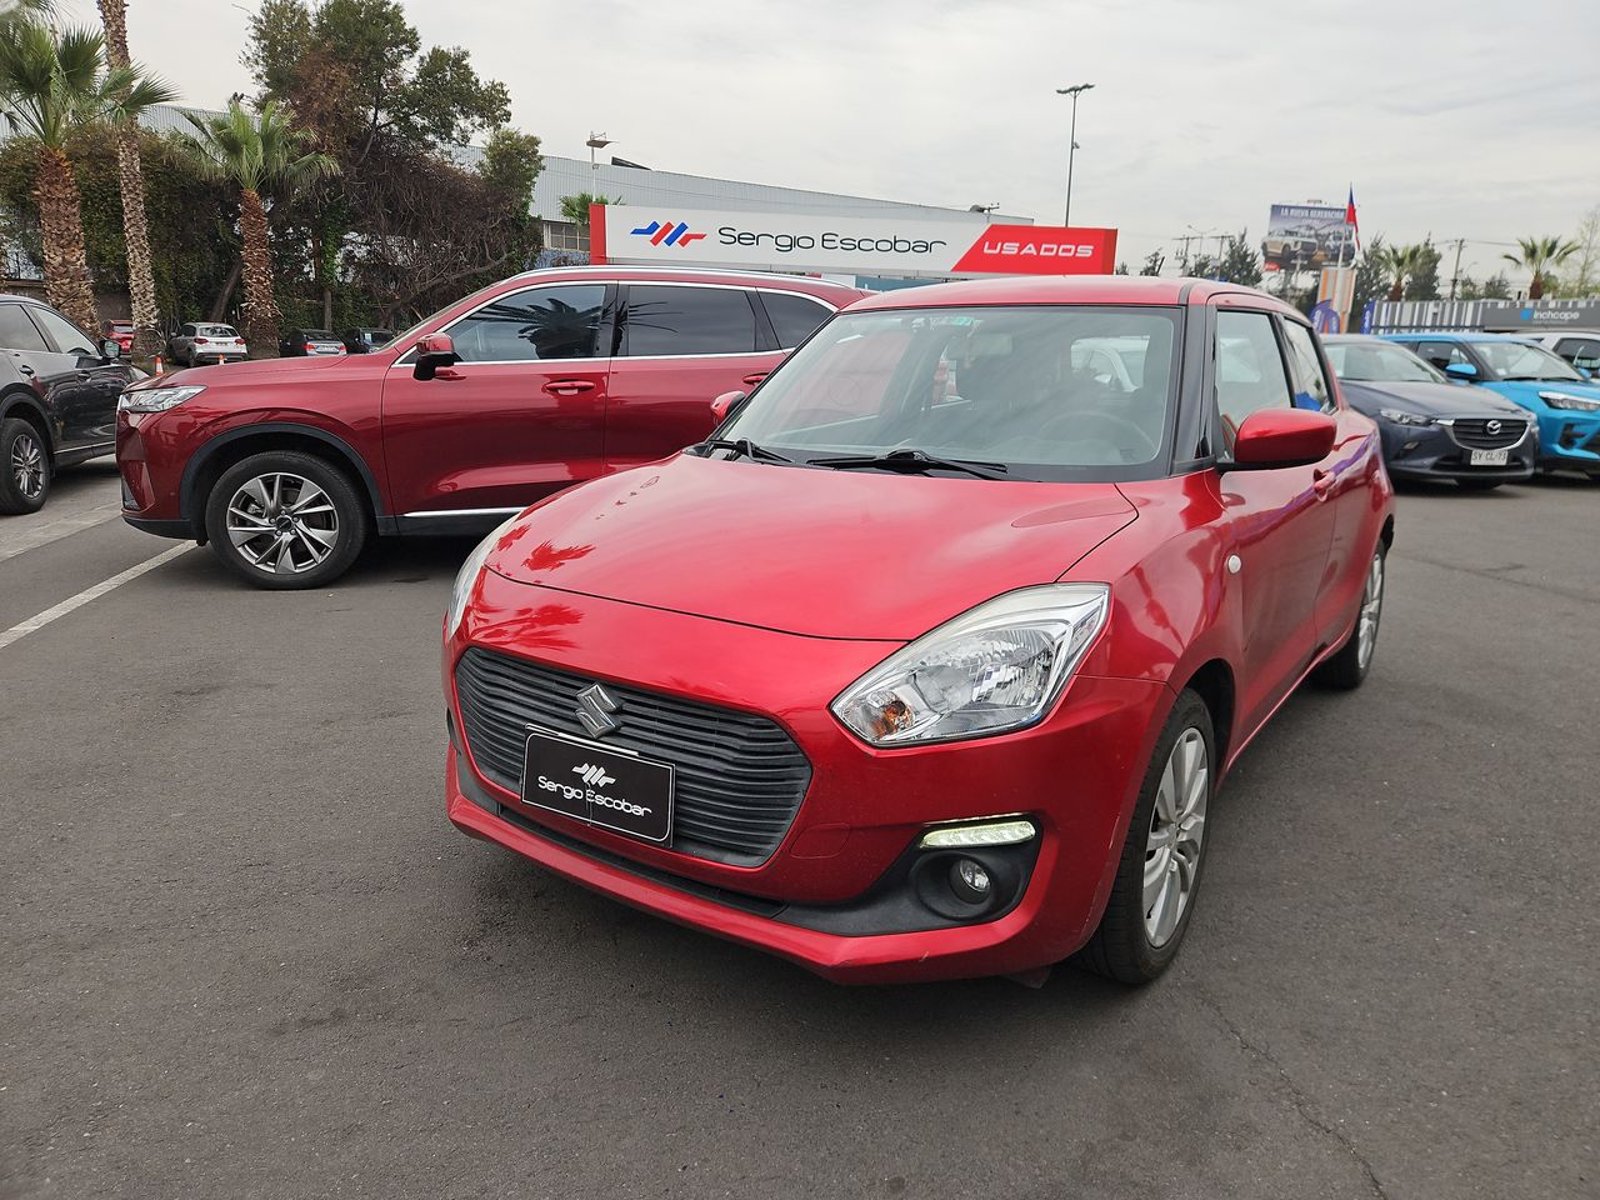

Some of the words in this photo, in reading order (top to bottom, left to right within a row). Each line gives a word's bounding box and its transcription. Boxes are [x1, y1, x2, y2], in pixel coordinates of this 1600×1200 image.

[718, 226, 815, 254] Sergio
[822, 232, 947, 255] Escobar
[982, 241, 1094, 258] USADOS
[1533, 309, 1580, 320] inchcape
[586, 790, 652, 817] Escobar
